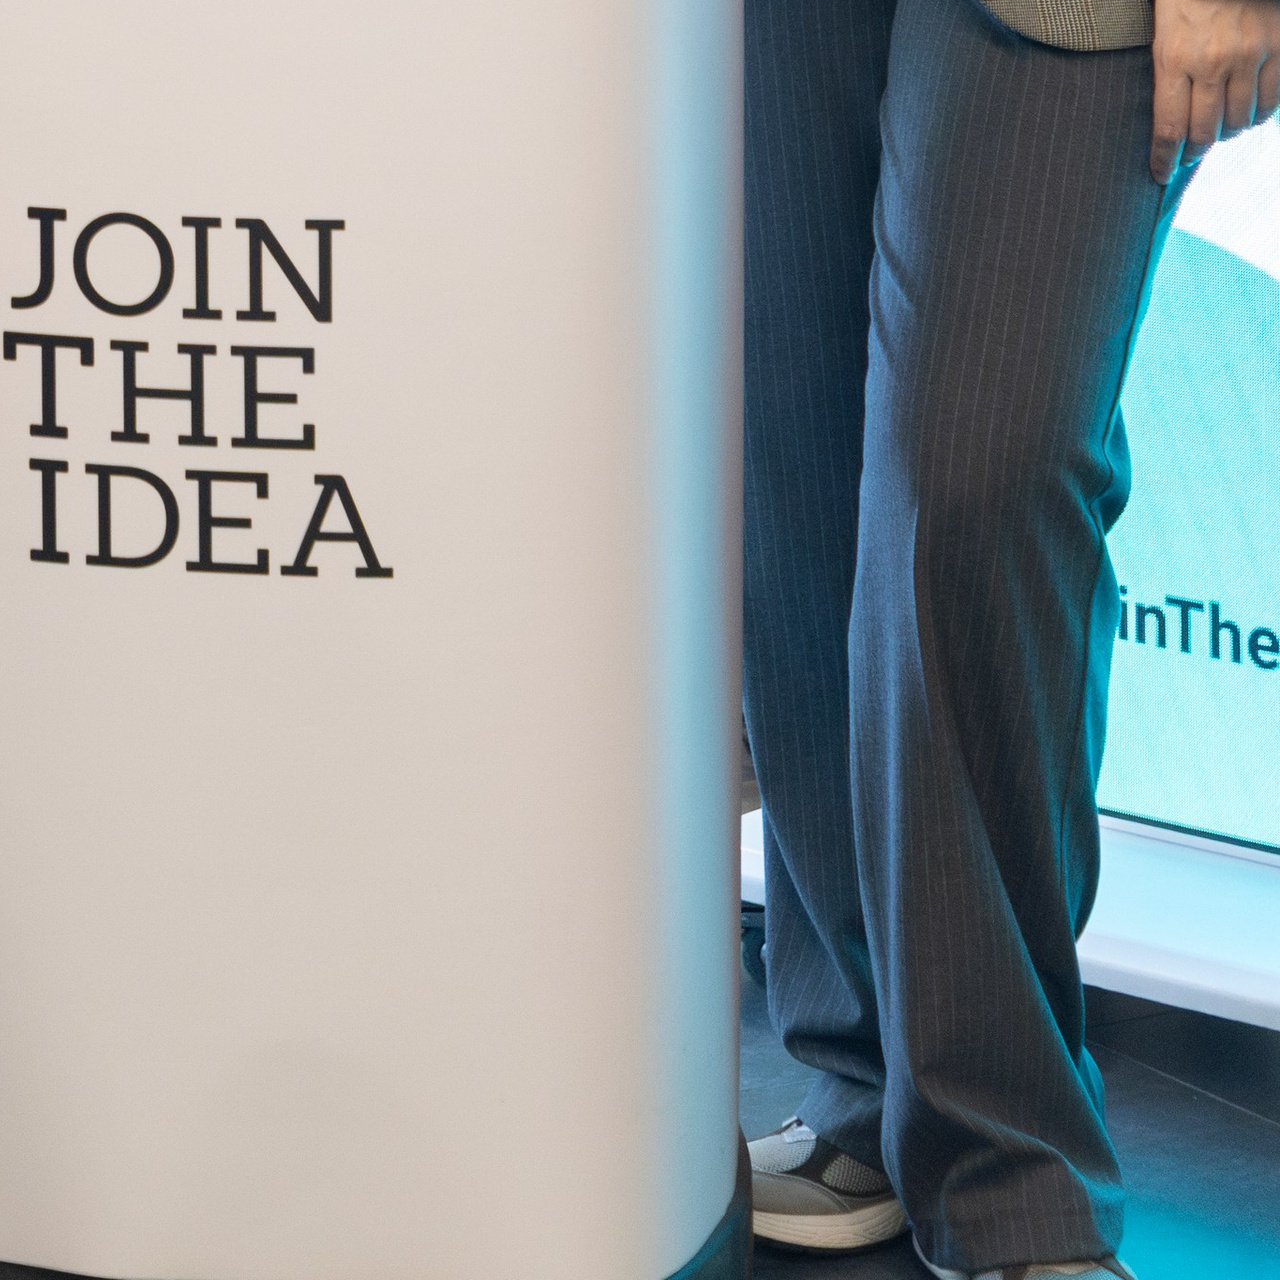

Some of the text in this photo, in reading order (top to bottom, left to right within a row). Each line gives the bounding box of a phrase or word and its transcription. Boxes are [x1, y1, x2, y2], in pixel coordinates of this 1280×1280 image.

[10, 205, 346, 324] JOIN
[2, 330, 317, 450] THE
[28, 457, 395, 579] IDEA
